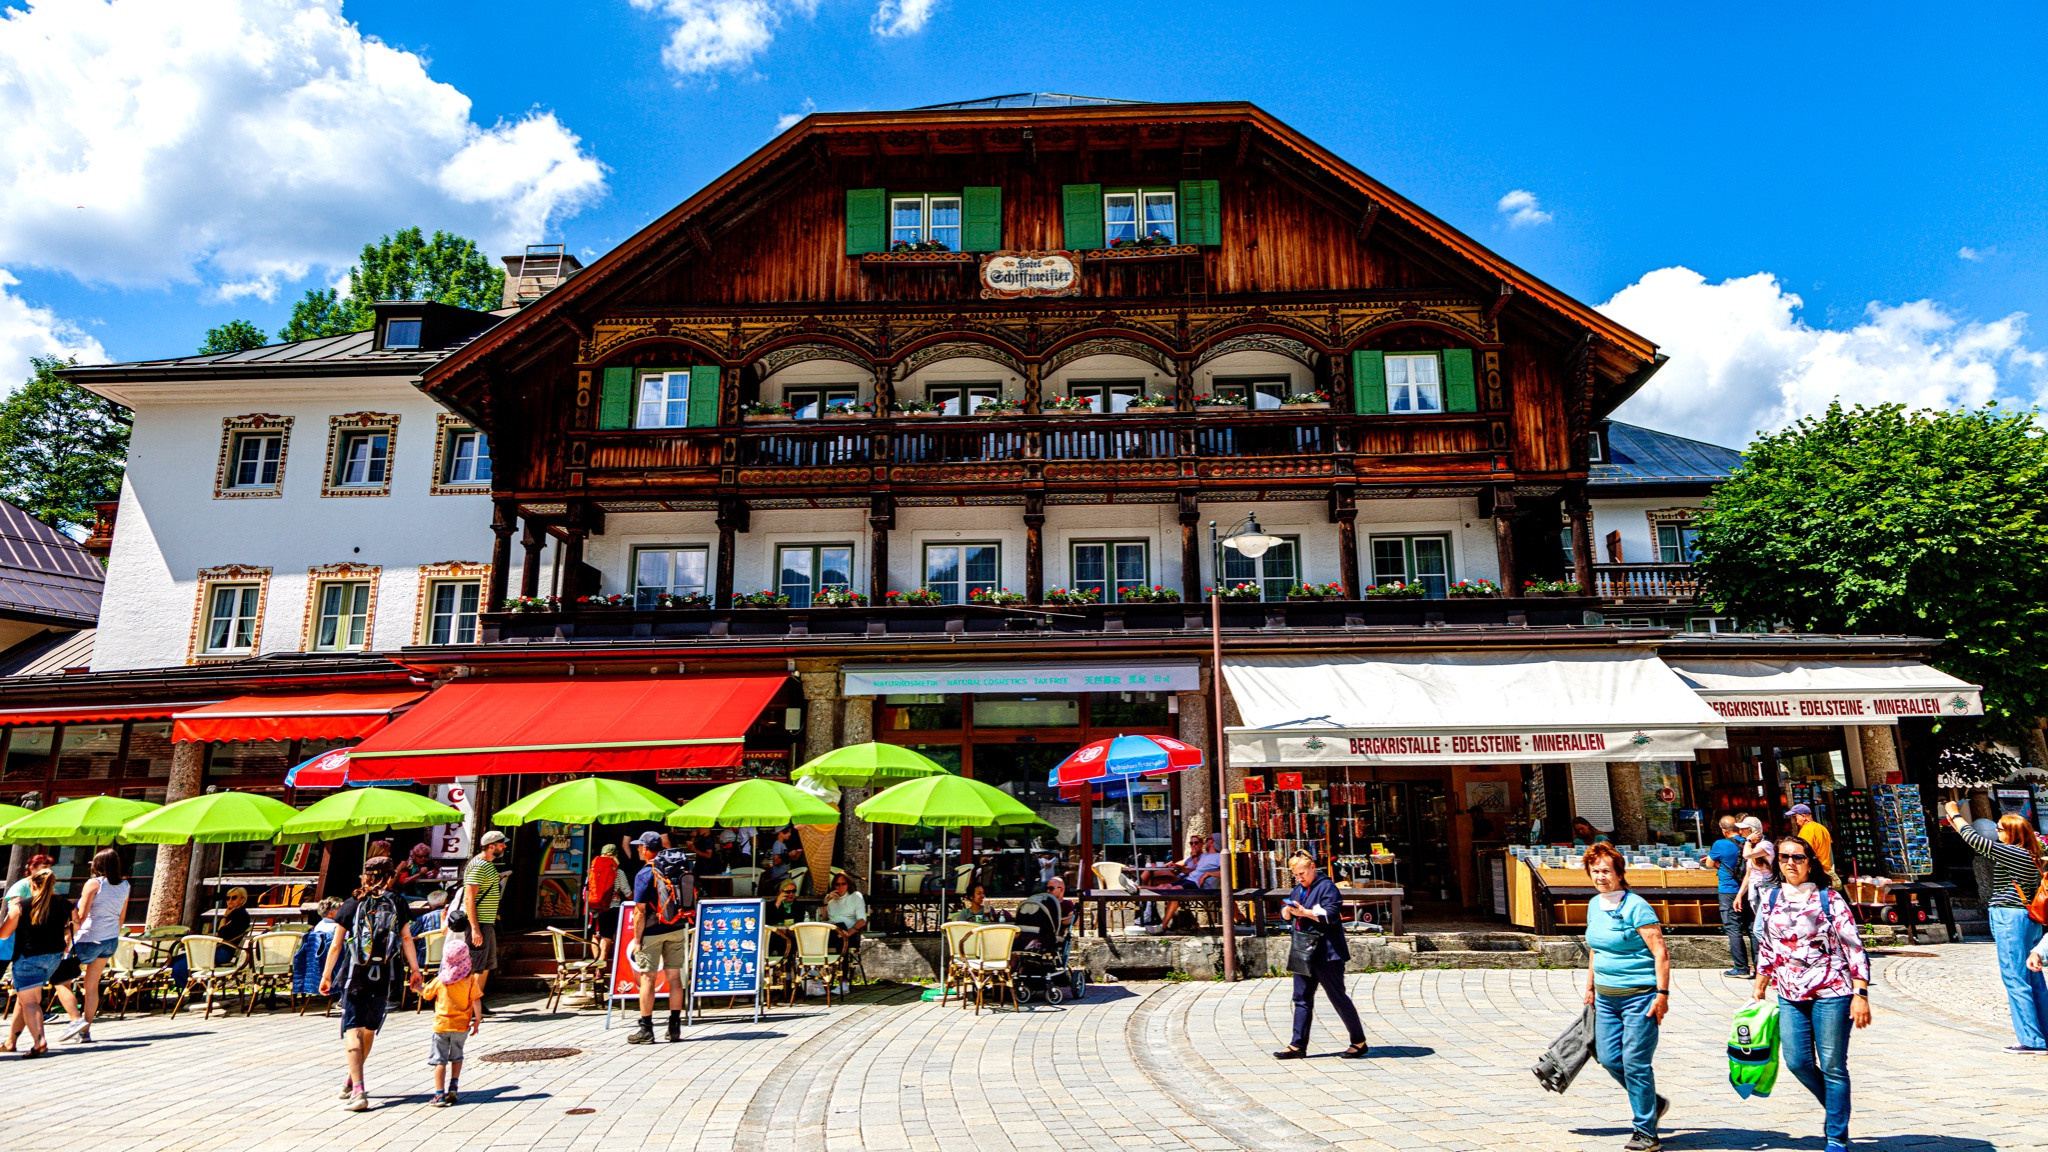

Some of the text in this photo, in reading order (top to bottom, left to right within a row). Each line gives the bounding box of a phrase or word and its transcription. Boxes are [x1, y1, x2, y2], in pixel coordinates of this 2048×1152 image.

[1016, 260, 1042, 268] Hotel
[873, 679, 938, 687] NATURKOSMETIK
[983, 678, 1027, 686] COSMETICS
[1800, 700, 1864, 715] EDELSTEINE
[1873, 698, 1941, 715] MINERALIEN
[1350, 733, 1606, 754] BERGKRISTALLE EDELSTEINE MINERALIEN
[441, 788, 465, 853] CFE
